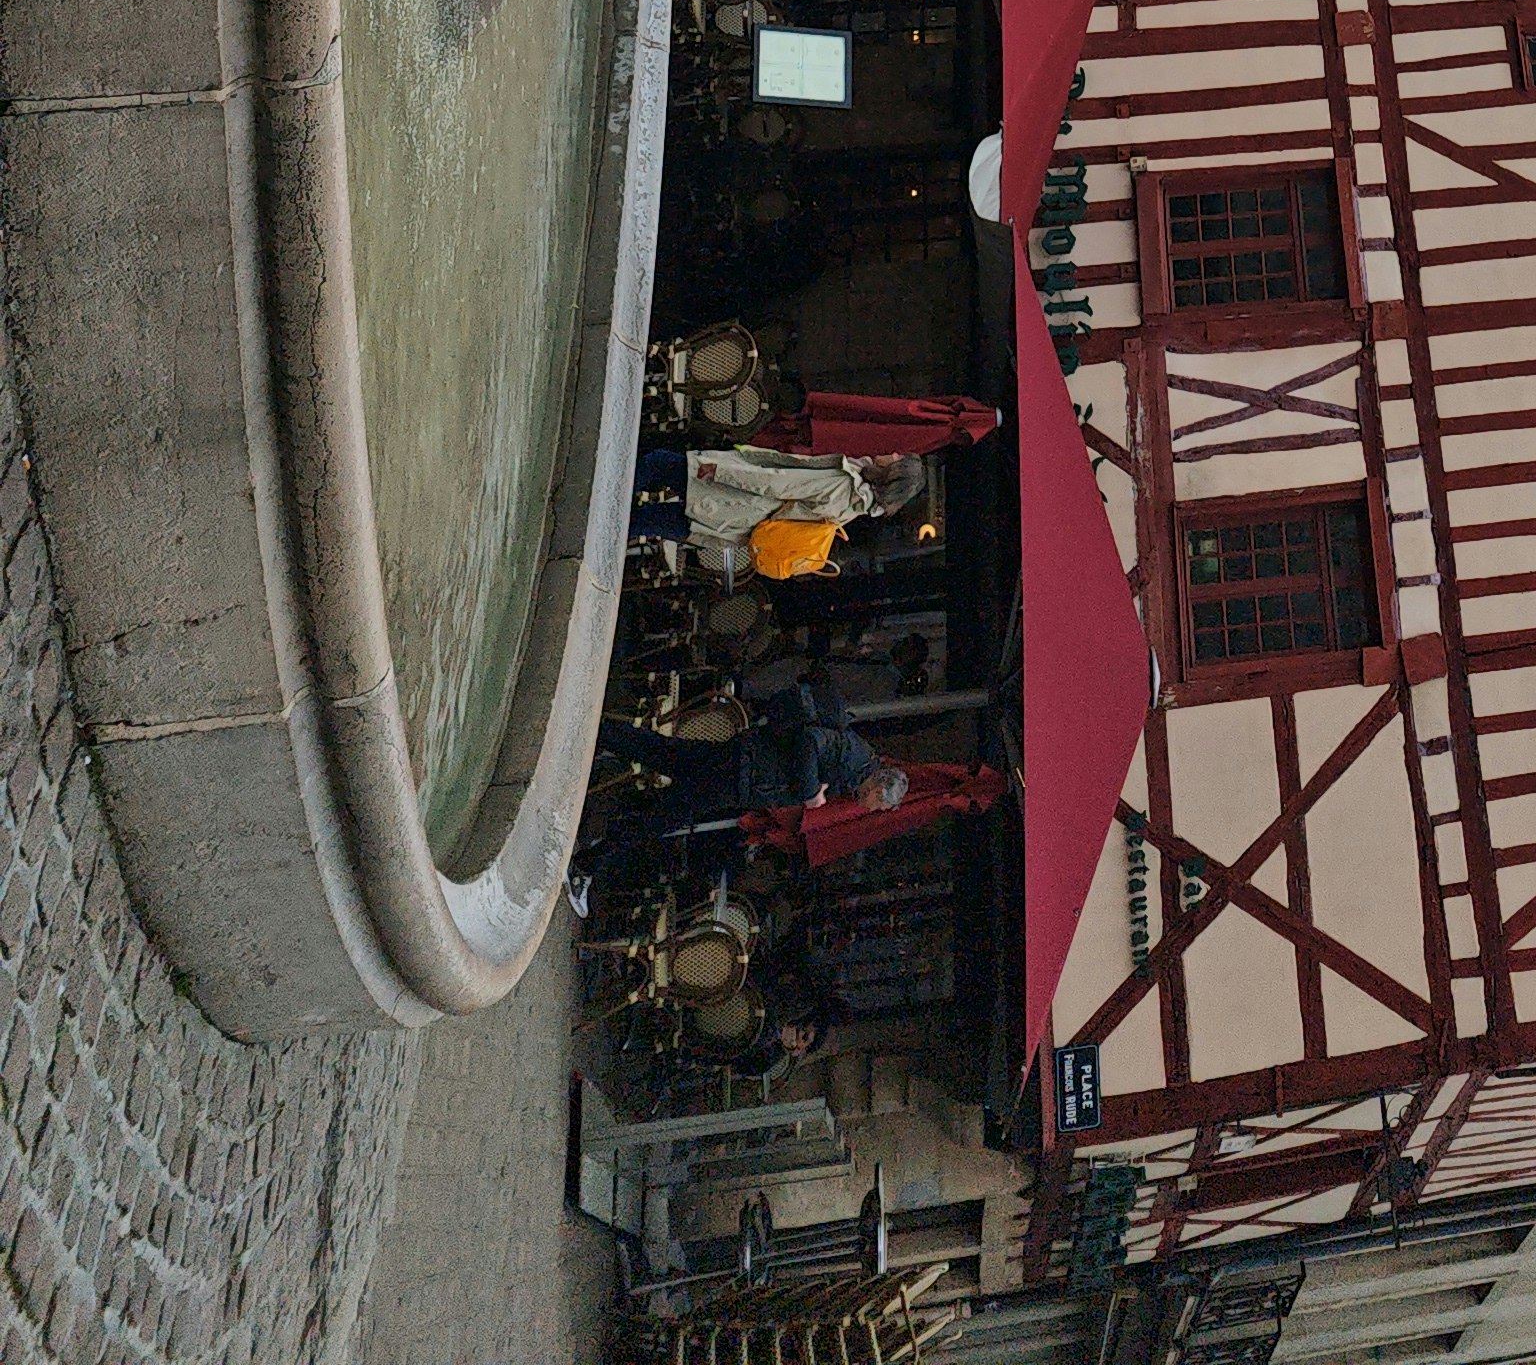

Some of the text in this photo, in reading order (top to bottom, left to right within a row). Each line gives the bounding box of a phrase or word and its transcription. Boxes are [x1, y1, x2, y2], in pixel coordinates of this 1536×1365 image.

[1041, 155, 1093, 378] Moulin
[1125, 810, 1151, 980] Restaurant
[1182, 857, 1207, 911] Bar
[1065, 1095, 1077, 1125] RUDE
[1081, 1064, 1093, 1110] PLACE
